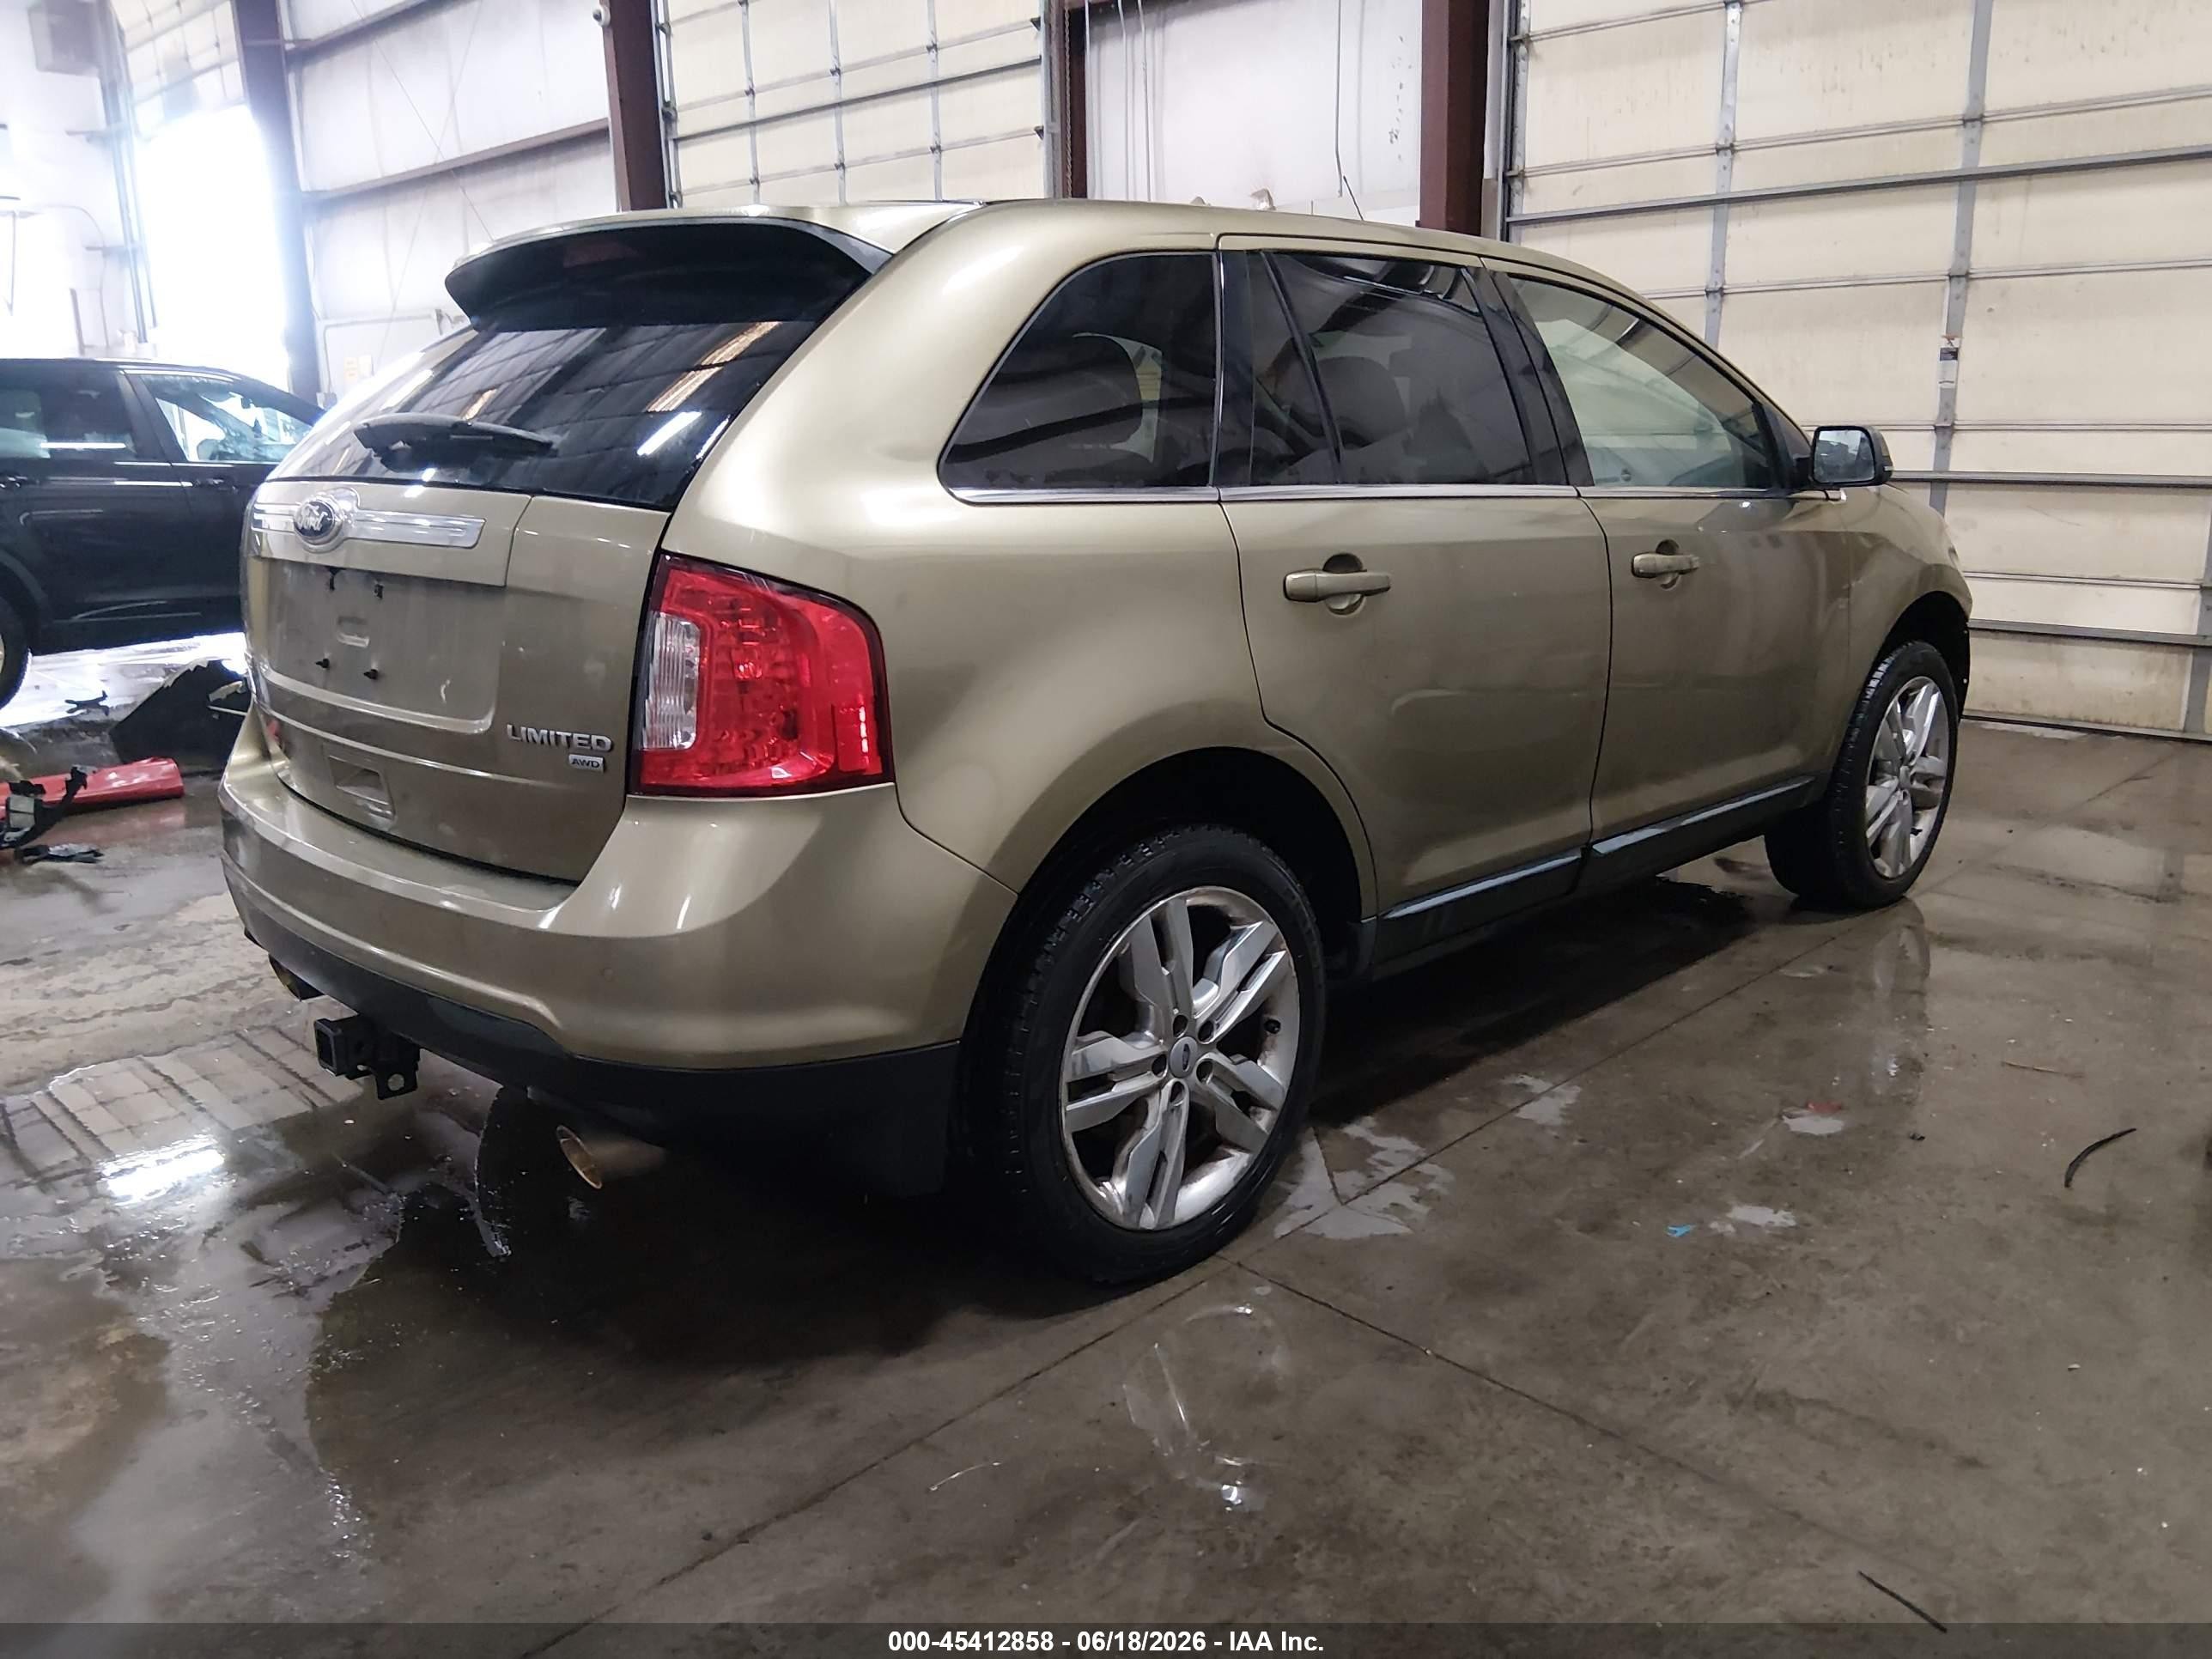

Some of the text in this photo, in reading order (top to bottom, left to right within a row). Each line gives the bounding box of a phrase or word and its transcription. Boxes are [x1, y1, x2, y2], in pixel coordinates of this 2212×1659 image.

[295, 503, 328, 532] Ford
[506, 724, 613, 752] LIMITED
[571, 757, 601, 769] AWD
